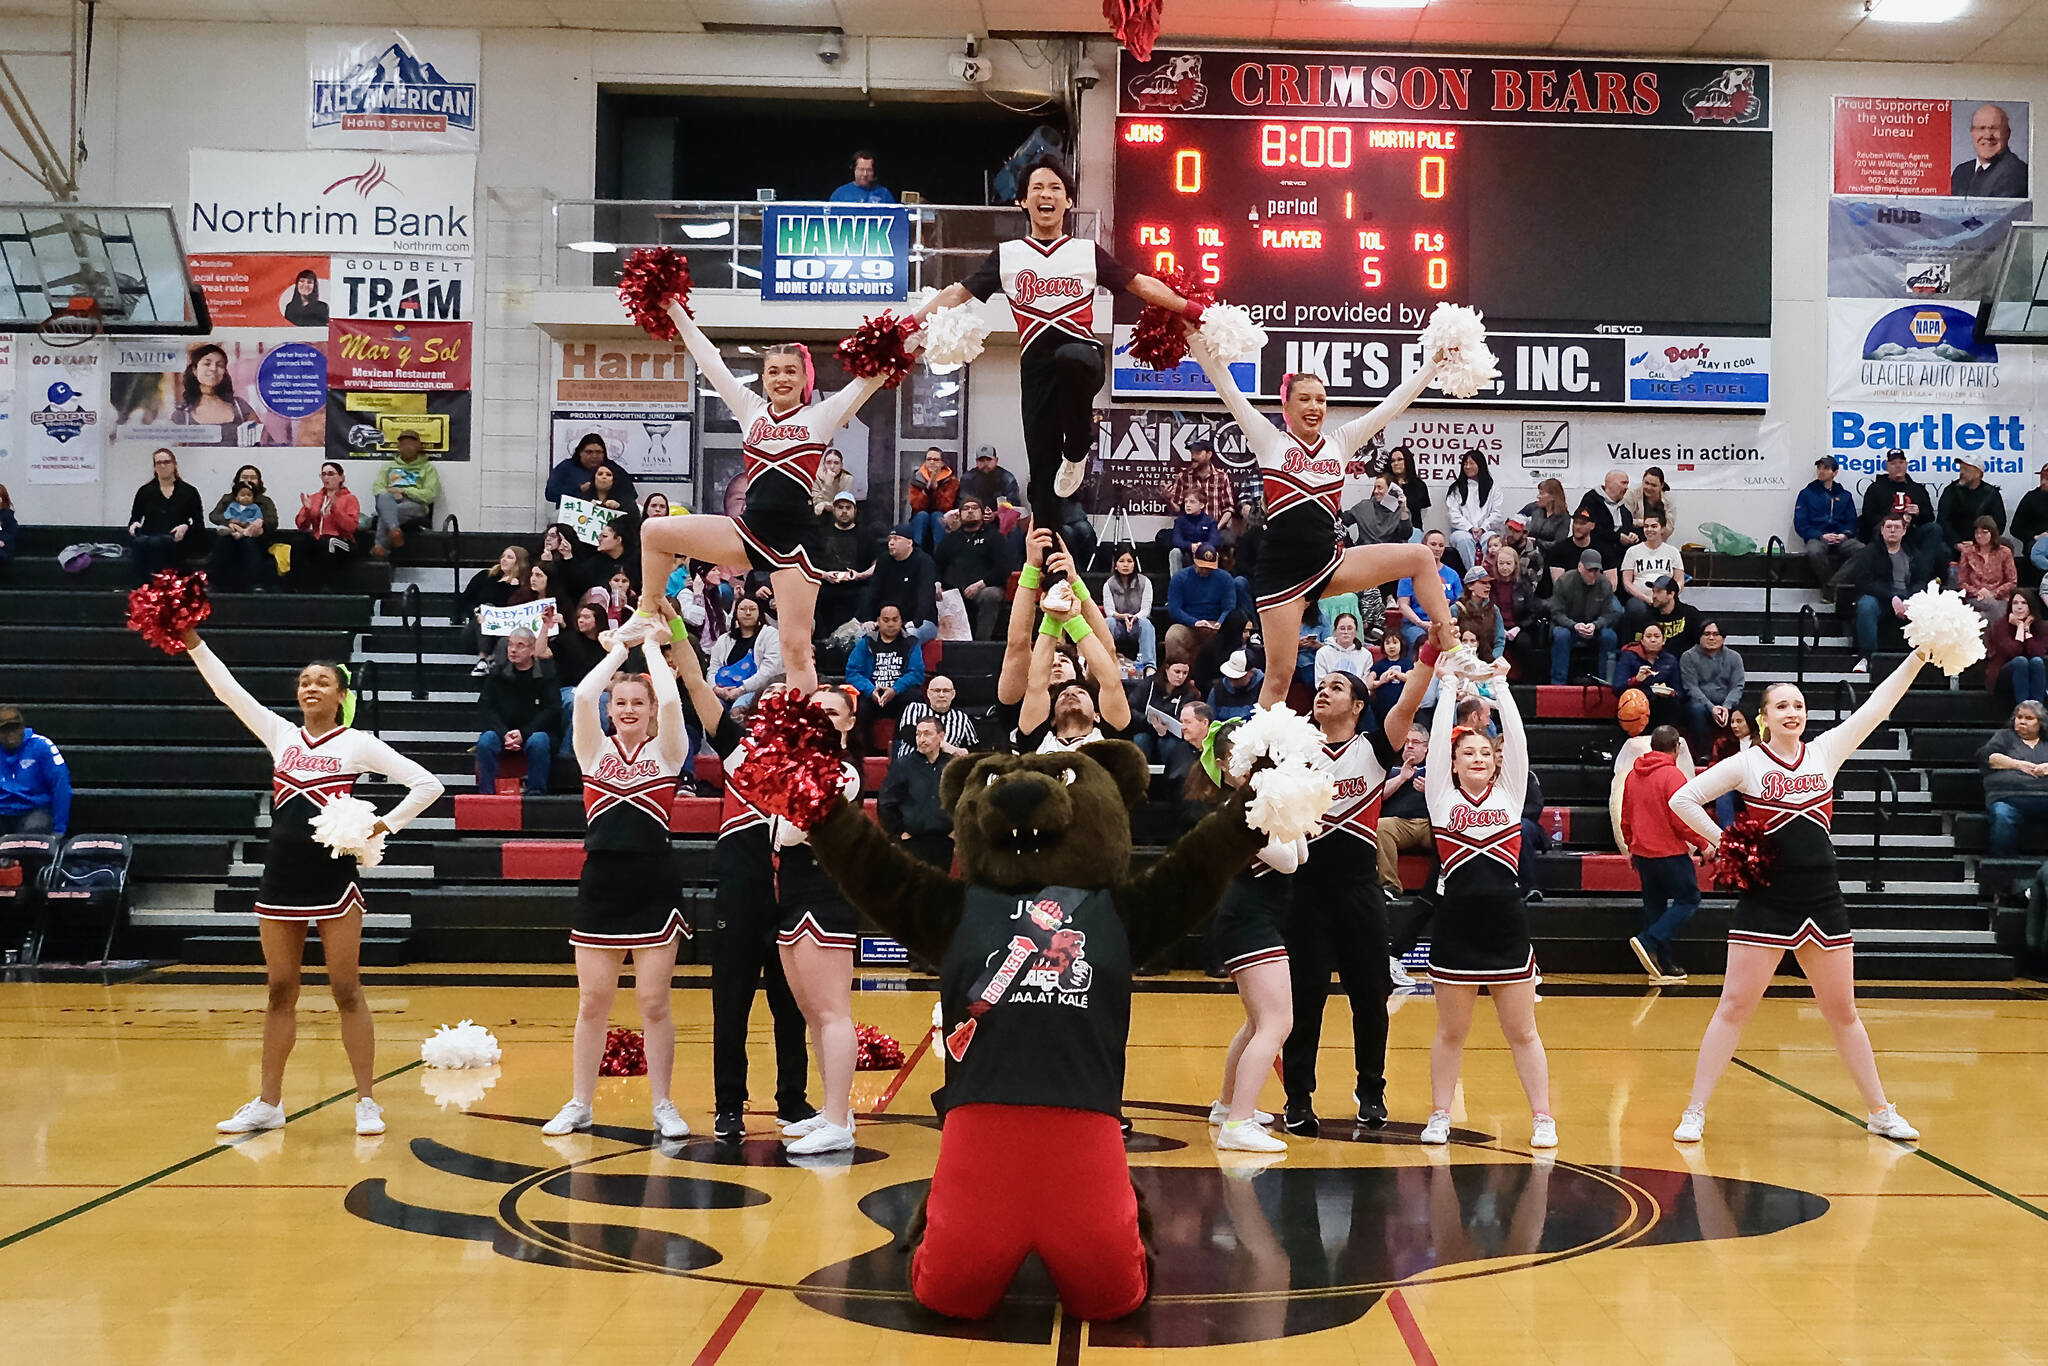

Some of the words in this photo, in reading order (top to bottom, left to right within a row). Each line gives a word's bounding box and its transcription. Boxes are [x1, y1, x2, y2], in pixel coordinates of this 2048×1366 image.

[1230, 62, 1472, 110] CRIMSON
[1491, 69, 1661, 115] BEARS
[319, 87, 358, 113] ALL
[363, 86, 471, 116] AMERICAN
[1838, 98, 1872, 110] Proud
[1875, 99, 1935, 113] Supporter
[1936, 100, 1949, 112] of
[347, 118, 386, 128] Home
[390, 118, 441, 129] Service
[1857, 113, 1877, 123] the
[1879, 113, 1914, 127] youth
[1917, 114, 1930, 124] of
[1369, 130, 1415, 149] NORTH
[1417, 131, 1456, 149] POLE
[1871, 126, 1914, 138] Juneau
[1261, 125, 1352, 168] 8:00
[1908, 153, 1929, 161] Agent
[1176, 150, 1201, 193] 0
[1420, 156, 1445, 199] 0
[1267, 197, 1318, 218] period
[1345, 191, 1353, 219] 1
[192, 202, 358, 235] Northrim
[375, 205, 468, 237] Bank
[1877, 208, 1922, 224] HUB
[393, 240, 470, 252] Northrim.com
[776, 215, 895, 257] HAWK
[1140, 226, 1170, 246] FLS
[1196, 227, 1224, 247] TOL
[1262, 230, 1322, 249] PLAYER
[1358, 231, 1385, 251] TOL
[1414, 233, 1445, 252] FLS
[346, 260, 464, 273] GOLDBELT
[775, 259, 894, 280] 107.9
[1428, 257, 1448, 289] 0
[215, 273, 249, 282] service
[1015, 269, 1083, 305] Bears
[343, 276, 462, 320] TRAM
[775, 281, 808, 294] HOME
[809, 281, 824, 294] OF
[825, 281, 847, 294] FOX
[848, 281, 894, 295] SPORTS
[1294, 301, 1392, 325] provided
[1399, 303, 1426, 328] by
[1915, 319, 1942, 335] NAPA
[32, 355, 50, 365] GO
[339, 334, 391, 360] Mar
[397, 345, 412, 368] y
[419, 338, 462, 363] Sol
[562, 343, 686, 379] Harri
[352, 367, 394, 378] Mexican
[395, 368, 446, 379] Restaurant
[1285, 341, 1389, 389] IKE'S
[1516, 345, 1600, 393] INC.
[1697, 359, 1720, 369] PLAY
[1723, 361, 1731, 369] IT
[1733, 357, 1755, 368] COOL
[344, 379, 454, 389] www.juneaumexican.com
[1861, 363, 1914, 387] GLACIER
[1919, 364, 1955, 387] AUTO
[1959, 365, 2000, 389] PARTS
[1704, 384, 1748, 394] FUEL
[603, 412, 646, 420] SUPPORTING
[747, 416, 810, 445] Bears
[1408, 422, 1494, 435] JUNEAU
[1832, 411, 2025, 451] Bartlett
[1402, 438, 1503, 450] DOUGLAS
[1606, 442, 1671, 461] Values
[1676, 443, 1694, 461] in
[1699, 444, 1765, 461] action.
[1281, 447, 1341, 476] Bears
[1743, 477, 1785, 485] SEALASKA
[564, 501, 583, 512] #1
[1636, 559, 1671, 573] MAMA
[277, 745, 342, 773] Bears
[594, 753, 660, 781] Bears
[1761, 770, 1828, 801] Bears
[1447, 804, 1510, 832] Bears
